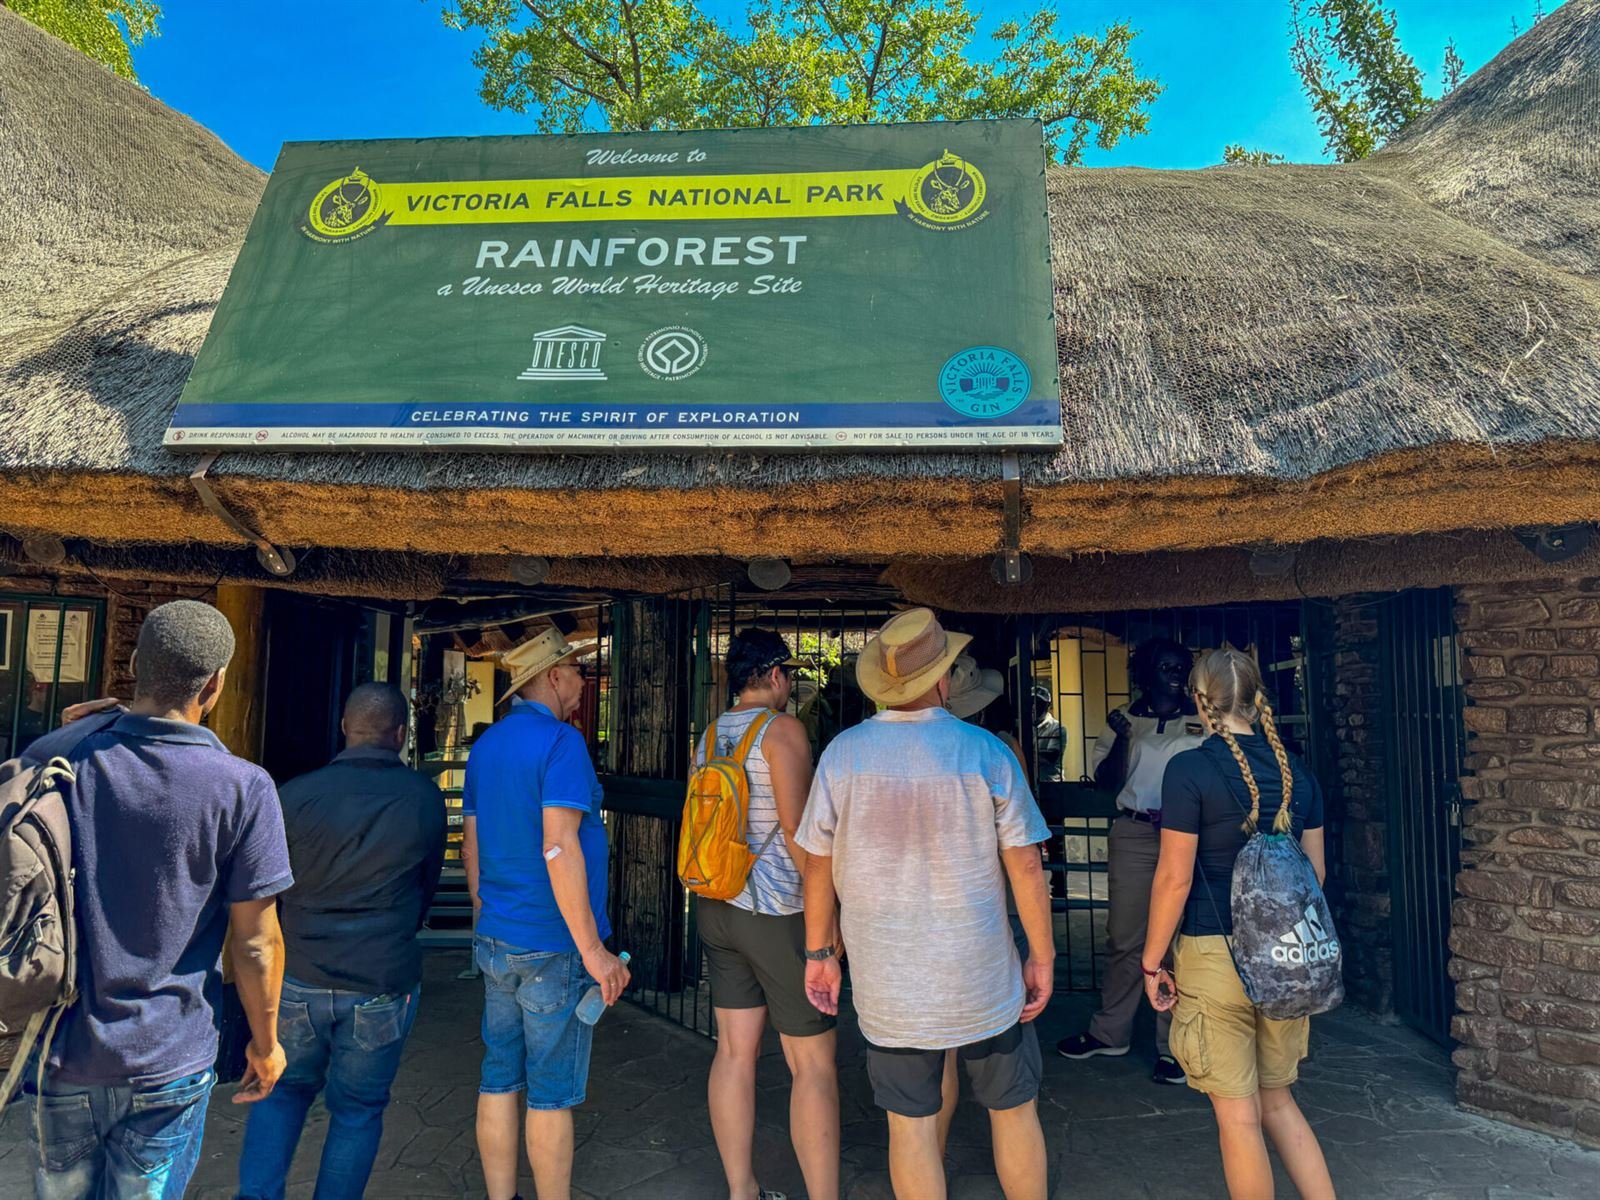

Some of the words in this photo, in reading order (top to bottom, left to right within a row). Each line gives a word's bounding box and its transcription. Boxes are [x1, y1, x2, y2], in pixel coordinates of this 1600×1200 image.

[586, 148, 679, 165] Welcome
[687, 148, 707, 163] to
[407, 193, 530, 212] VICTORIA
[545, 189, 632, 209] FALLS
[648, 187, 792, 207] NATIONAL
[806, 183, 885, 203] PARK
[947, 223, 967, 232] WITH
[475, 235, 807, 268] RAINFOREST
[437, 284, 453, 296] a
[462, 276, 543, 296] Unesco
[552, 276, 629, 296] World
[632, 274, 739, 300] Heritage
[748, 274, 802, 295] Site
[532, 341, 601, 369] UNESCO
[945, 352, 995, 396] VICTORIA
[1001, 356, 1025, 394] FALLS
[411, 410, 529, 422] CELEBRATING
[539, 411, 572, 422] THE
[581, 411, 637, 423] SPIRIT
[646, 412, 669, 423] OF
[678, 411, 800, 423] EXPLORATION
[970, 402, 1001, 413] GIN
[503, 432, 515, 440] THE
[1271, 940, 1340, 964] adidas
